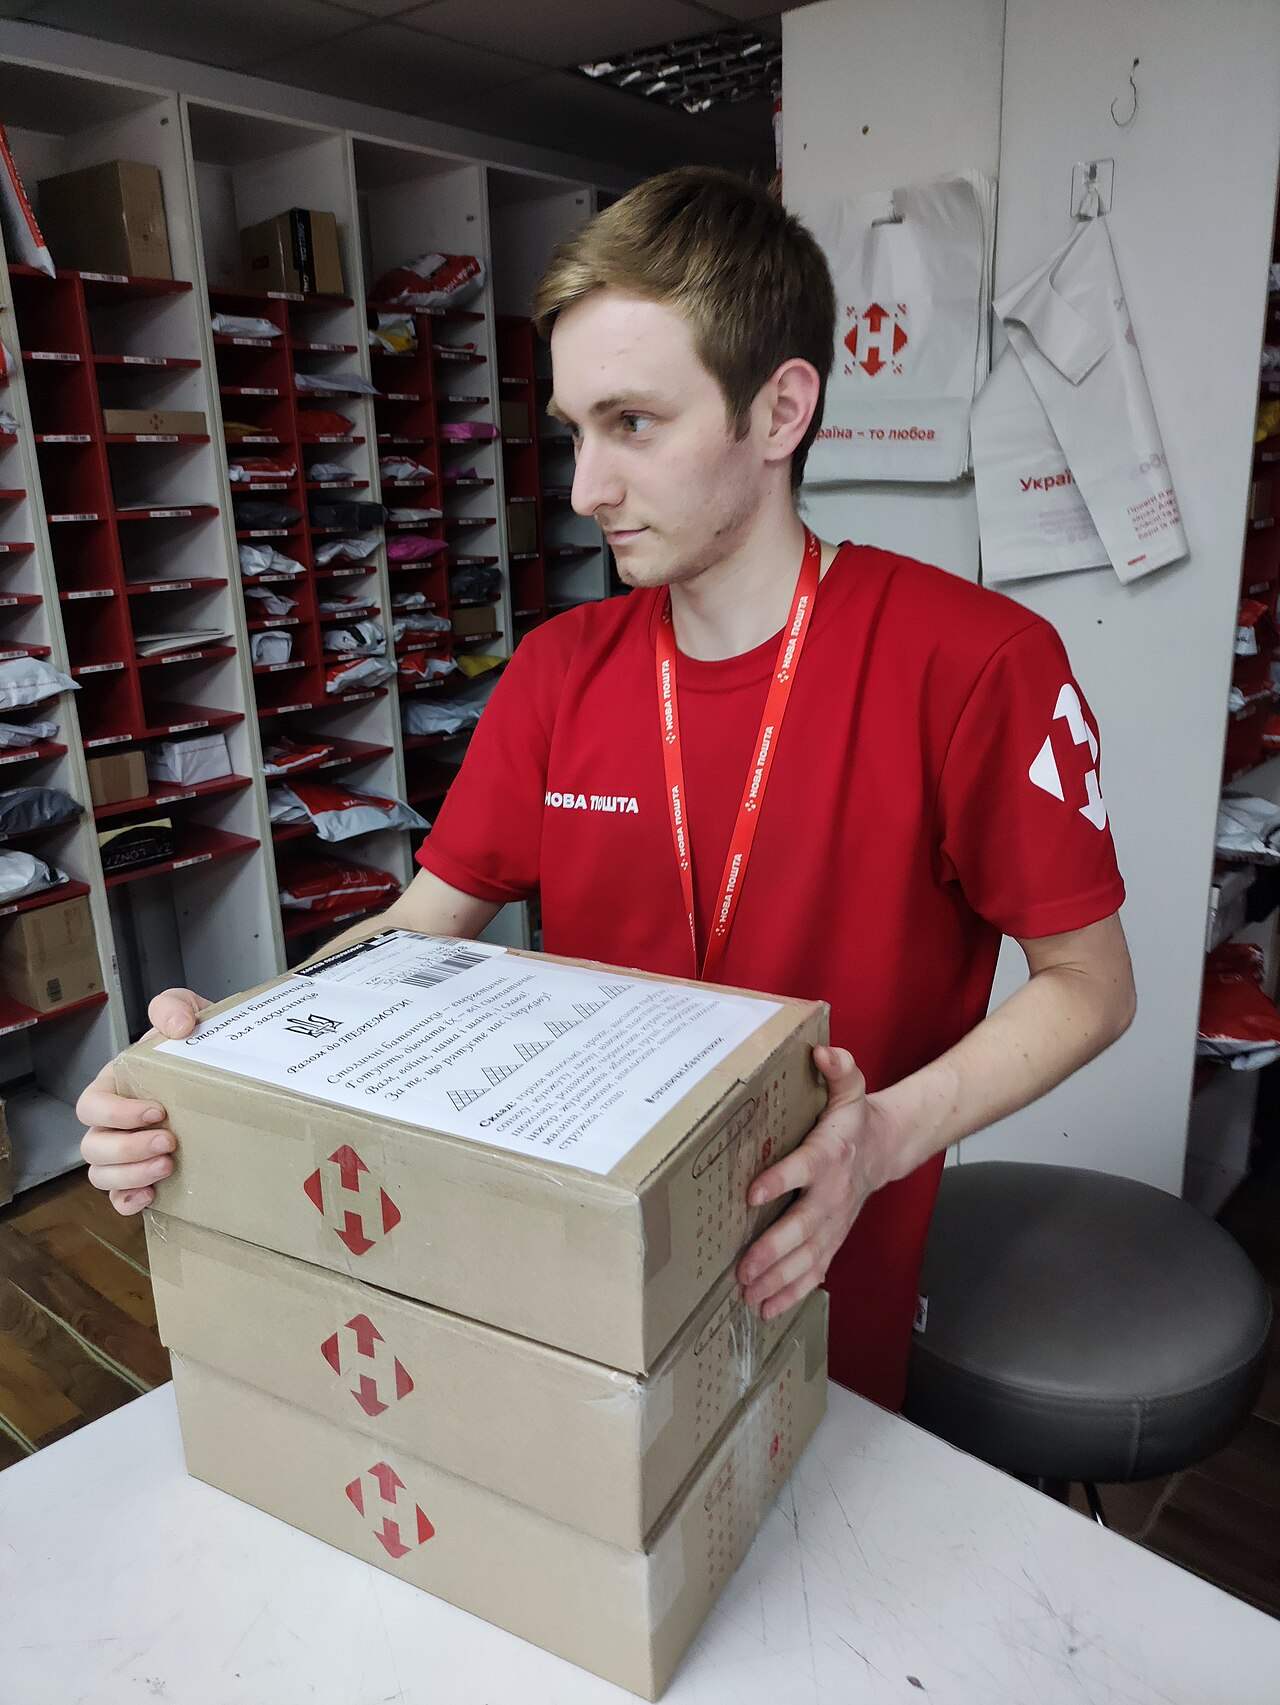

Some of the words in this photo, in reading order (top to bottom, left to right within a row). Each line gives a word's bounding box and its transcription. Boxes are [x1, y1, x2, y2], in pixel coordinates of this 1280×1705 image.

[816, 425, 853, 441] раїна
[869, 428, 885, 440] то
[888, 425, 936, 441] любов
[1019, 469, 1072, 491] Украї
[781, 638, 798, 669] НОВА
[791, 595, 809, 638] ПОШТА
[662, 659, 671, 697] ПОШТА
[664, 699, 674, 731] НОВА
[756, 726, 774, 767] ПОШТА
[749, 767, 764, 798] НОВА
[590, 795, 640, 814] ПОШТА
[671, 785, 682, 825] ПОШТА
[677, 826, 686, 857] НОВА
[719, 892, 733, 922] НОВА
[726, 853, 743, 892] ПОШТА
[185, 1010, 249, 1046] Столичні
[228, 1025, 254, 1041] для
[255, 993, 318, 1025] захисників
[327, 1048, 385, 1084] Столичні
[381, 1012, 443, 1049] батончики
[400, 1026, 448, 1053] дівчата
[286, 1049, 327, 1074] Разом
[326, 1041, 341, 1052] до
